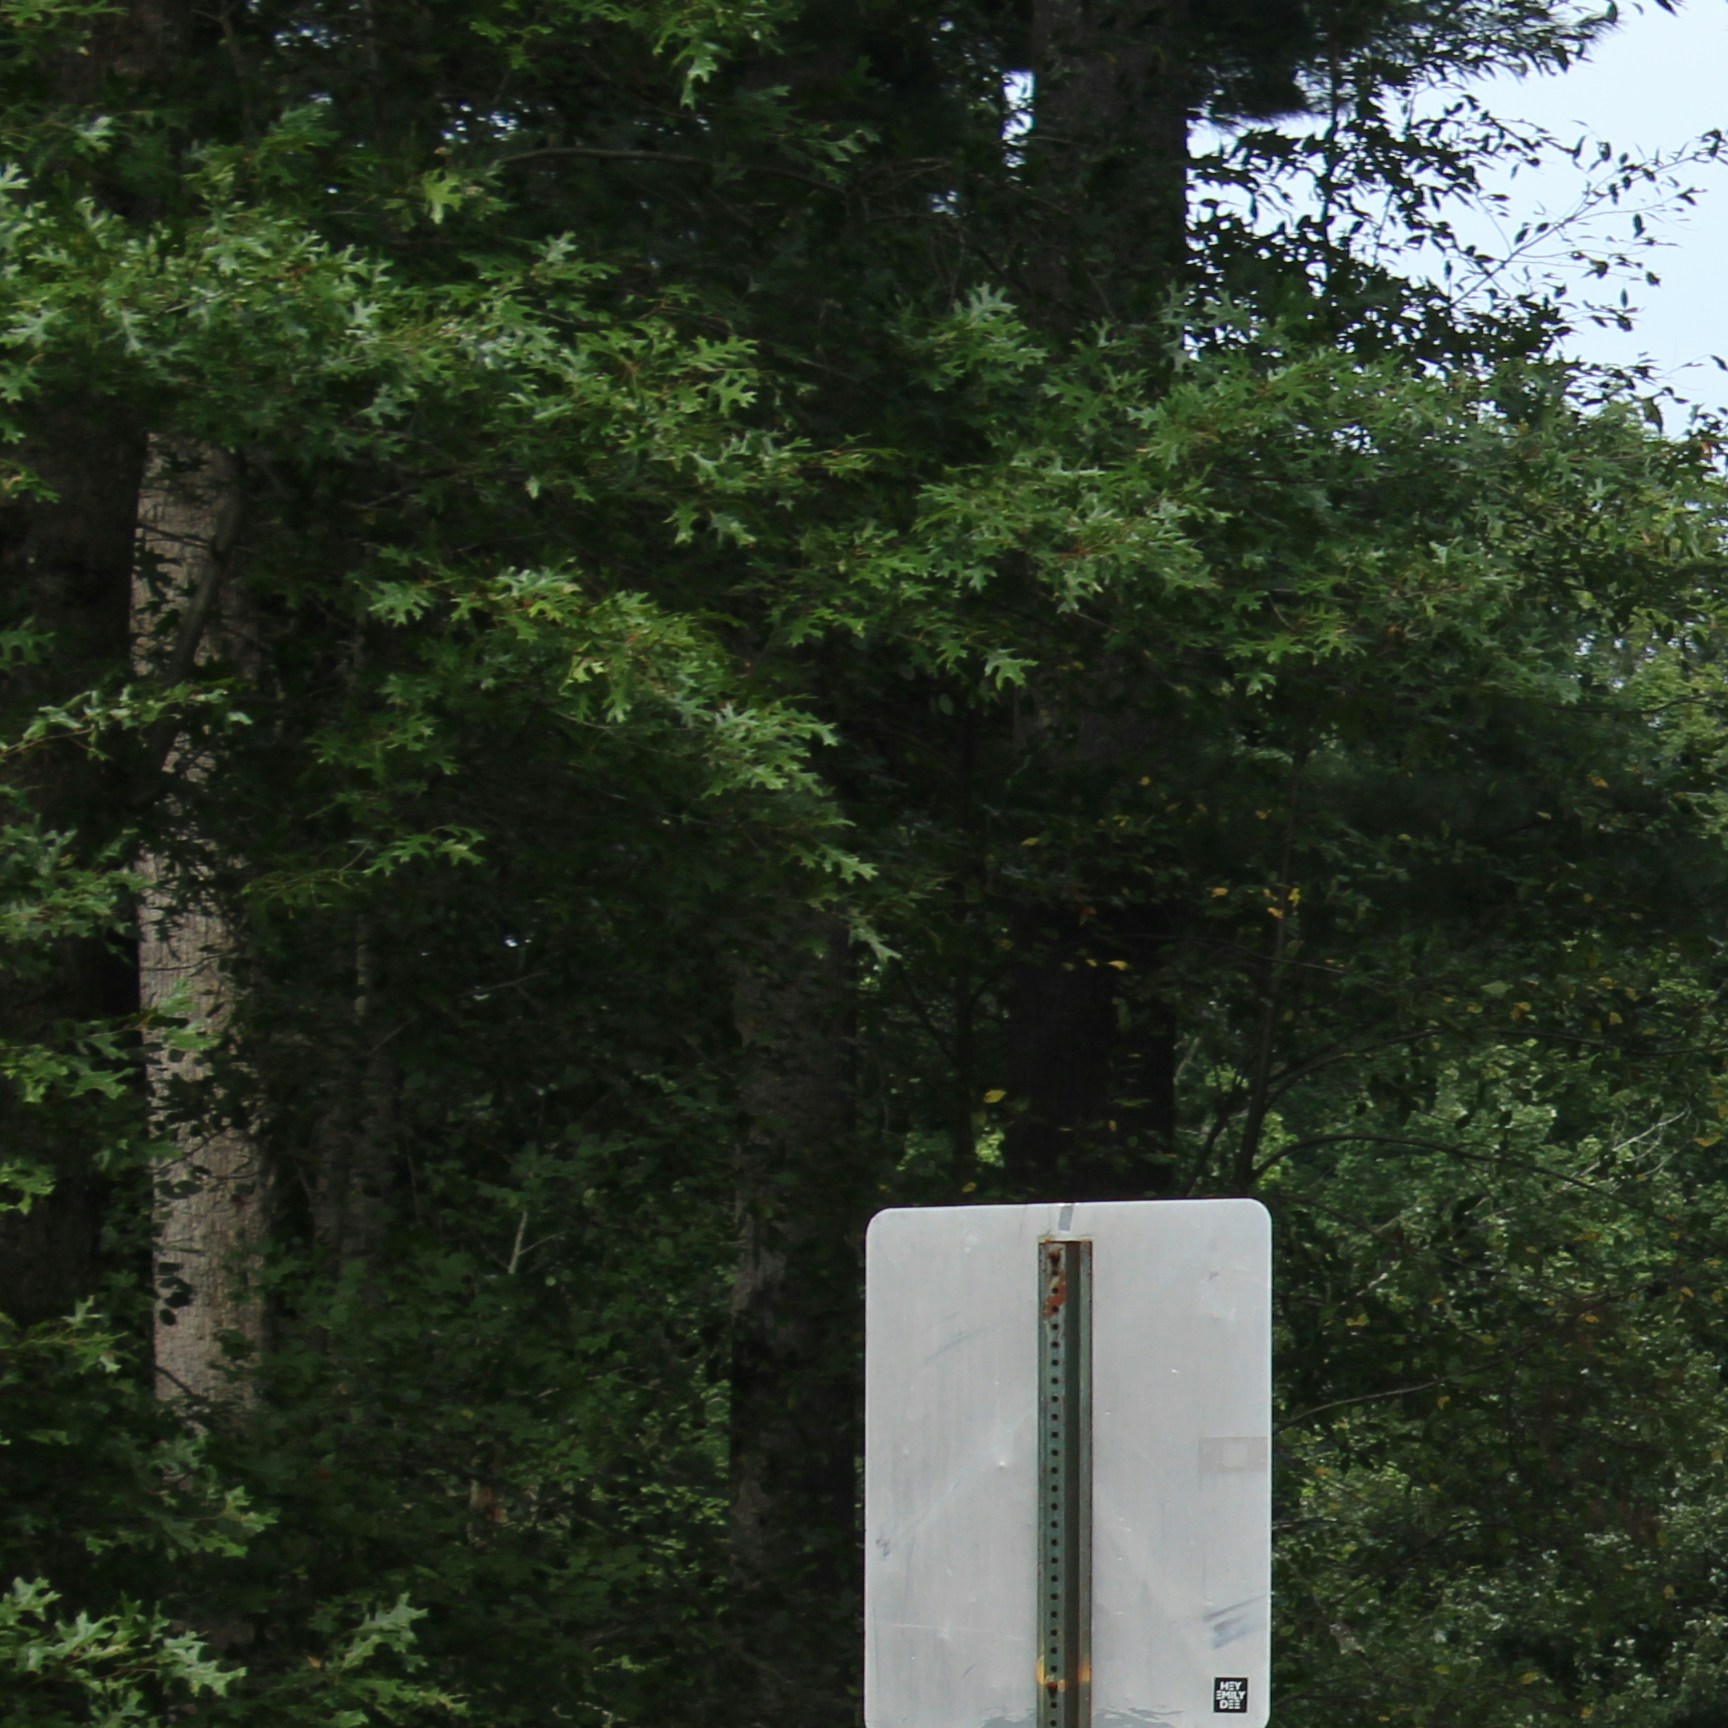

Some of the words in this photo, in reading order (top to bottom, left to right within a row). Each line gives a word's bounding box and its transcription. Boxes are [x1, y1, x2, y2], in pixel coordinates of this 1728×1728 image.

[1220, 1681, 1242, 1691] HEY
[1216, 1690, 1246, 1700] EMILY
[1219, 1700, 1241, 1710] DEE
